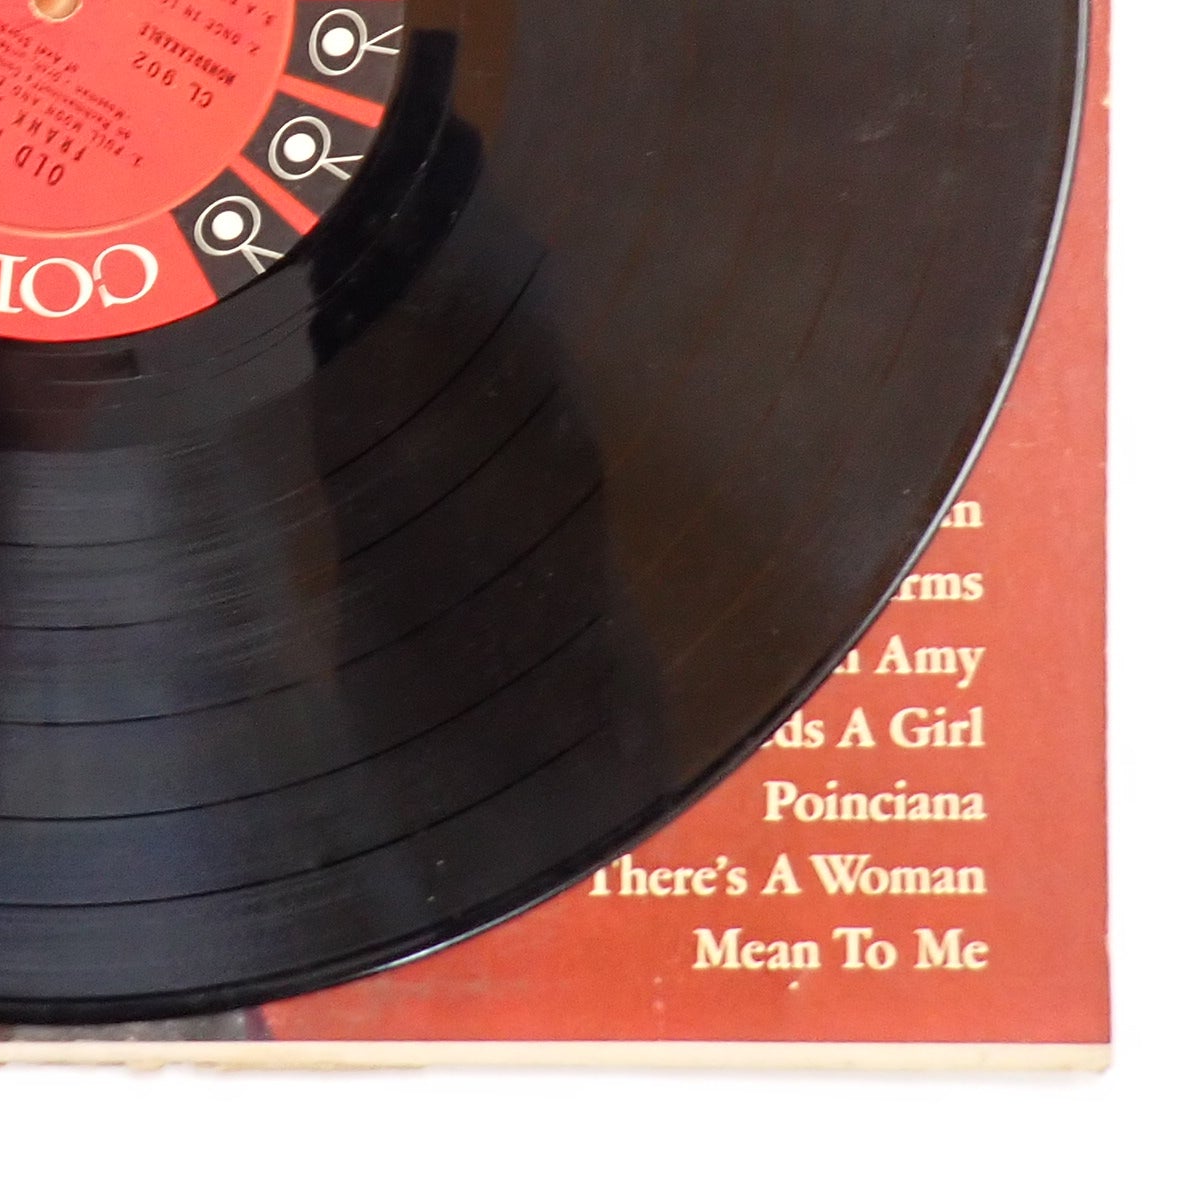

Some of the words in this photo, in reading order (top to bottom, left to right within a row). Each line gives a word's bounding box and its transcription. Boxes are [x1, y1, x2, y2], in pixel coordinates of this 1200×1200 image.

[180, 3, 201, 24] IN
[202, 17, 242, 48] ONCE
[129, 48, 178, 88] 902
[136, 20, 236, 89] NONBREAKABLE
[9, 81, 41, 108] AND
[182, 80, 215, 110] CL
[11, 108, 87, 163] FRANK
[43, 101, 84, 134] MOON
[86, 127, 125, 157] FULL
[11, 142, 67, 188] OLD
[891, 571, 984, 601] rms
[874, 634, 986, 689] Amy
[761, 709, 826, 748] ds
[835, 706, 876, 748] A
[889, 706, 986, 748] Girl
[763, 779, 987, 822] Poinciana
[760, 854, 801, 896] A
[810, 853, 987, 895] Woman
[692, 927, 821, 970] Mean
[832, 926, 898, 970] To
[913, 927, 990, 971] Me
